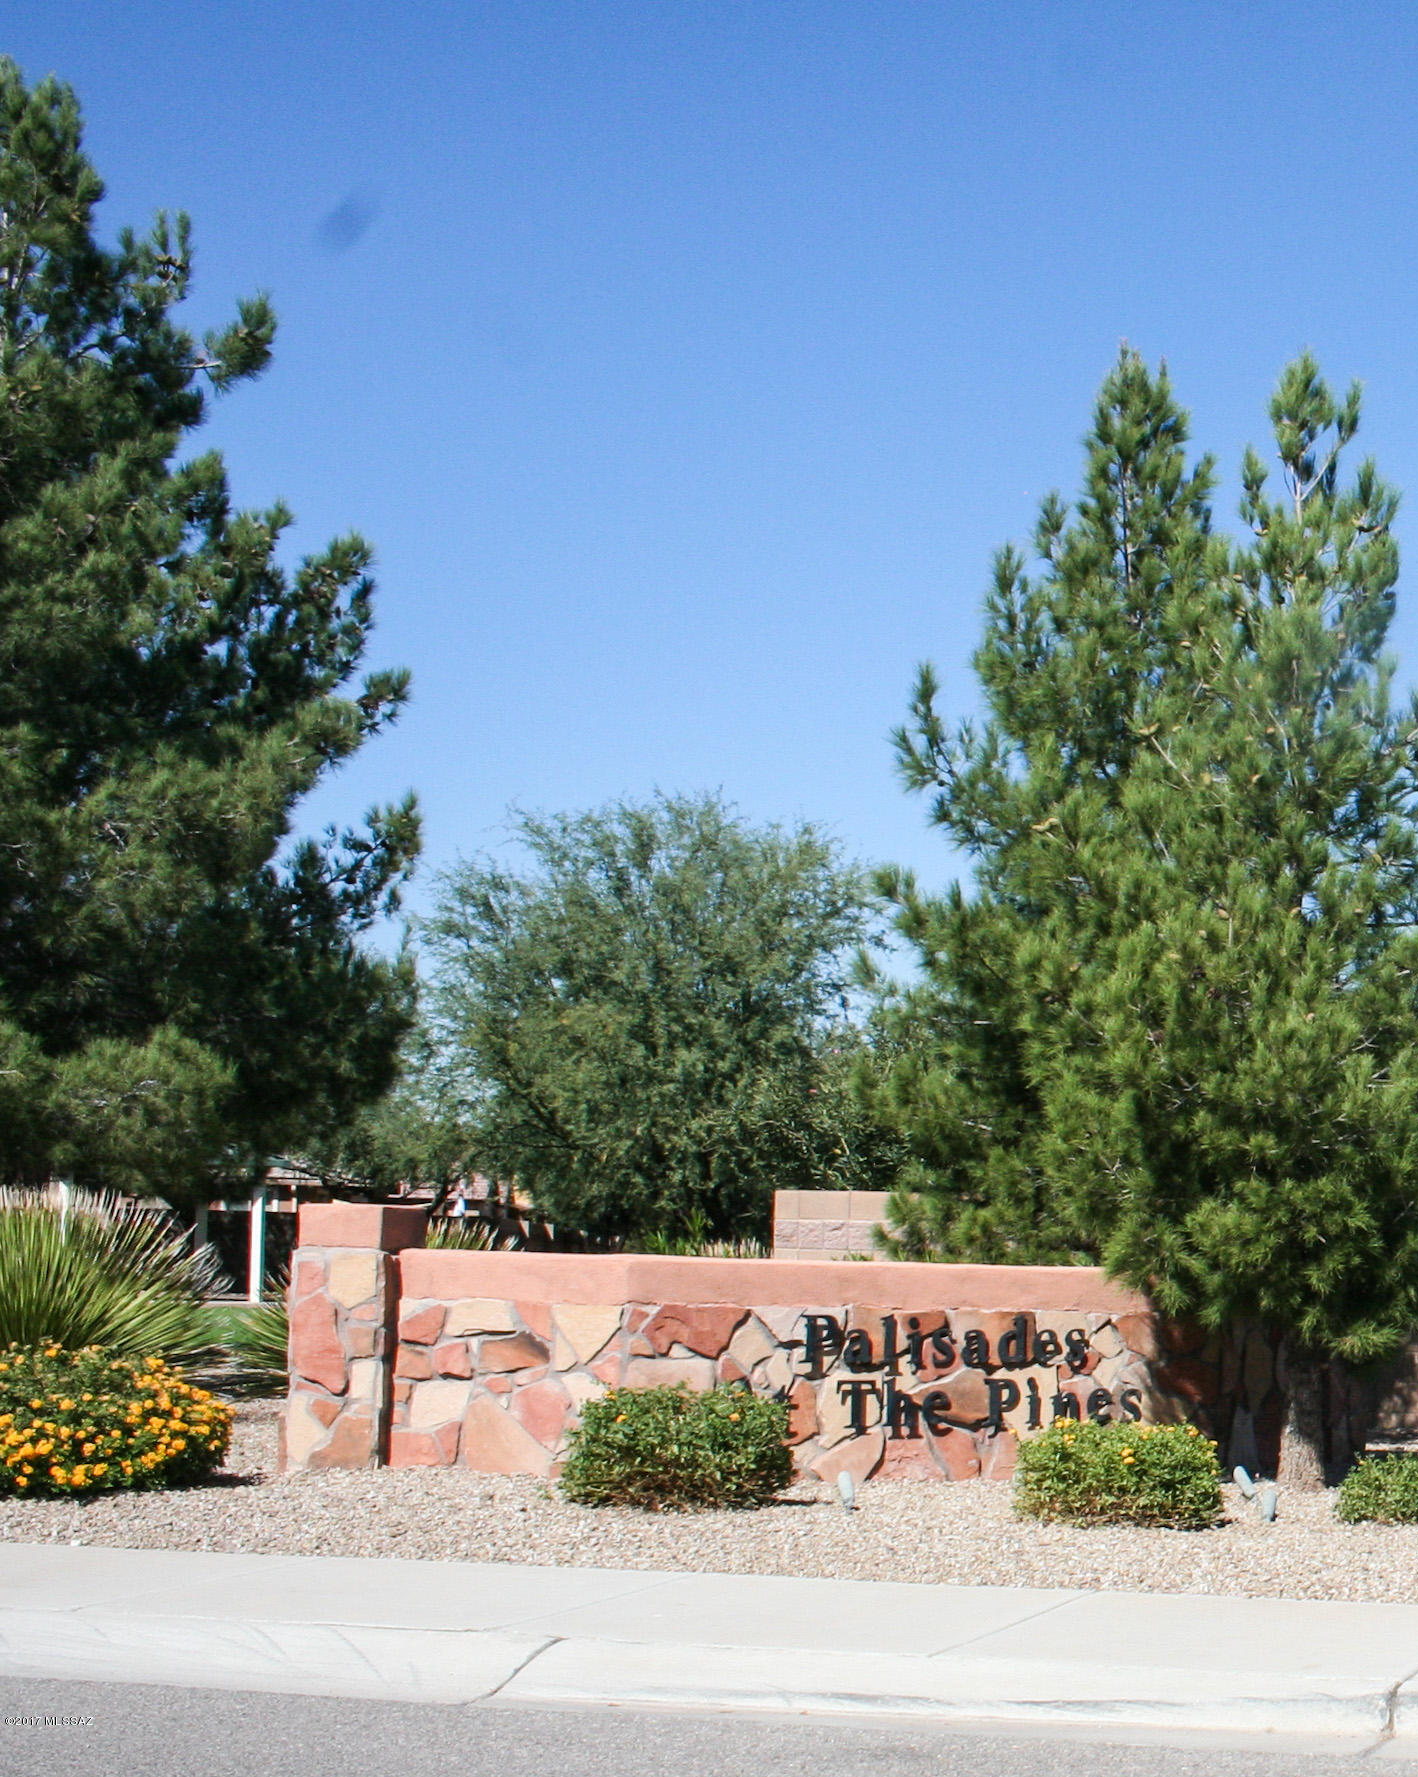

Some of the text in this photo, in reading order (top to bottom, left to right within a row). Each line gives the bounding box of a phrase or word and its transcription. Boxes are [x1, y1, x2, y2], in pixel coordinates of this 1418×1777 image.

[798, 1312, 1090, 1371] Palisades
[837, 1377, 953, 1433] The
[984, 1376, 1143, 1431] Pines
